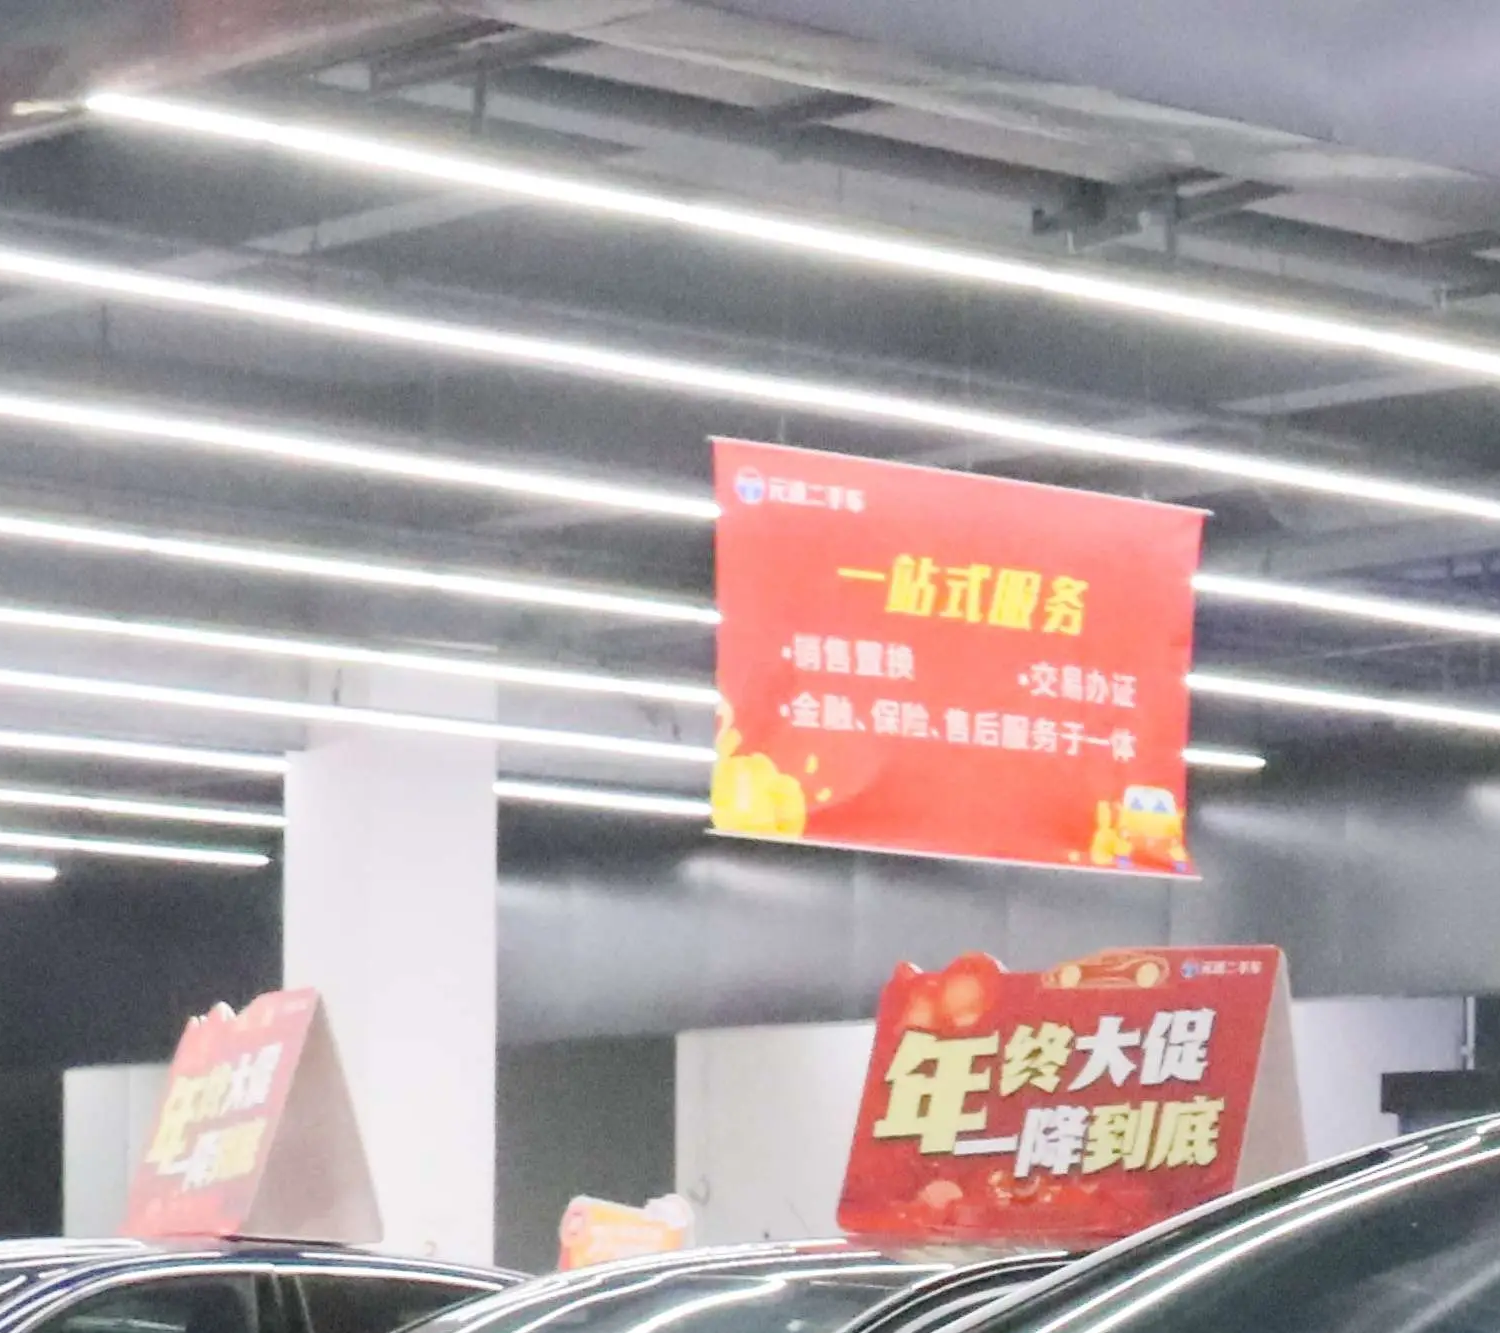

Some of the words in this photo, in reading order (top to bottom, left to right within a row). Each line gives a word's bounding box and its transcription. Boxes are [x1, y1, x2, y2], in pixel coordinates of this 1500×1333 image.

[836, 553, 1089, 636] 一站式服务
[1030, 660, 1137, 708] 交易办证
[873, 1006, 1218, 1156] 年终大促
[953, 1096, 1226, 1179] 一降到底
